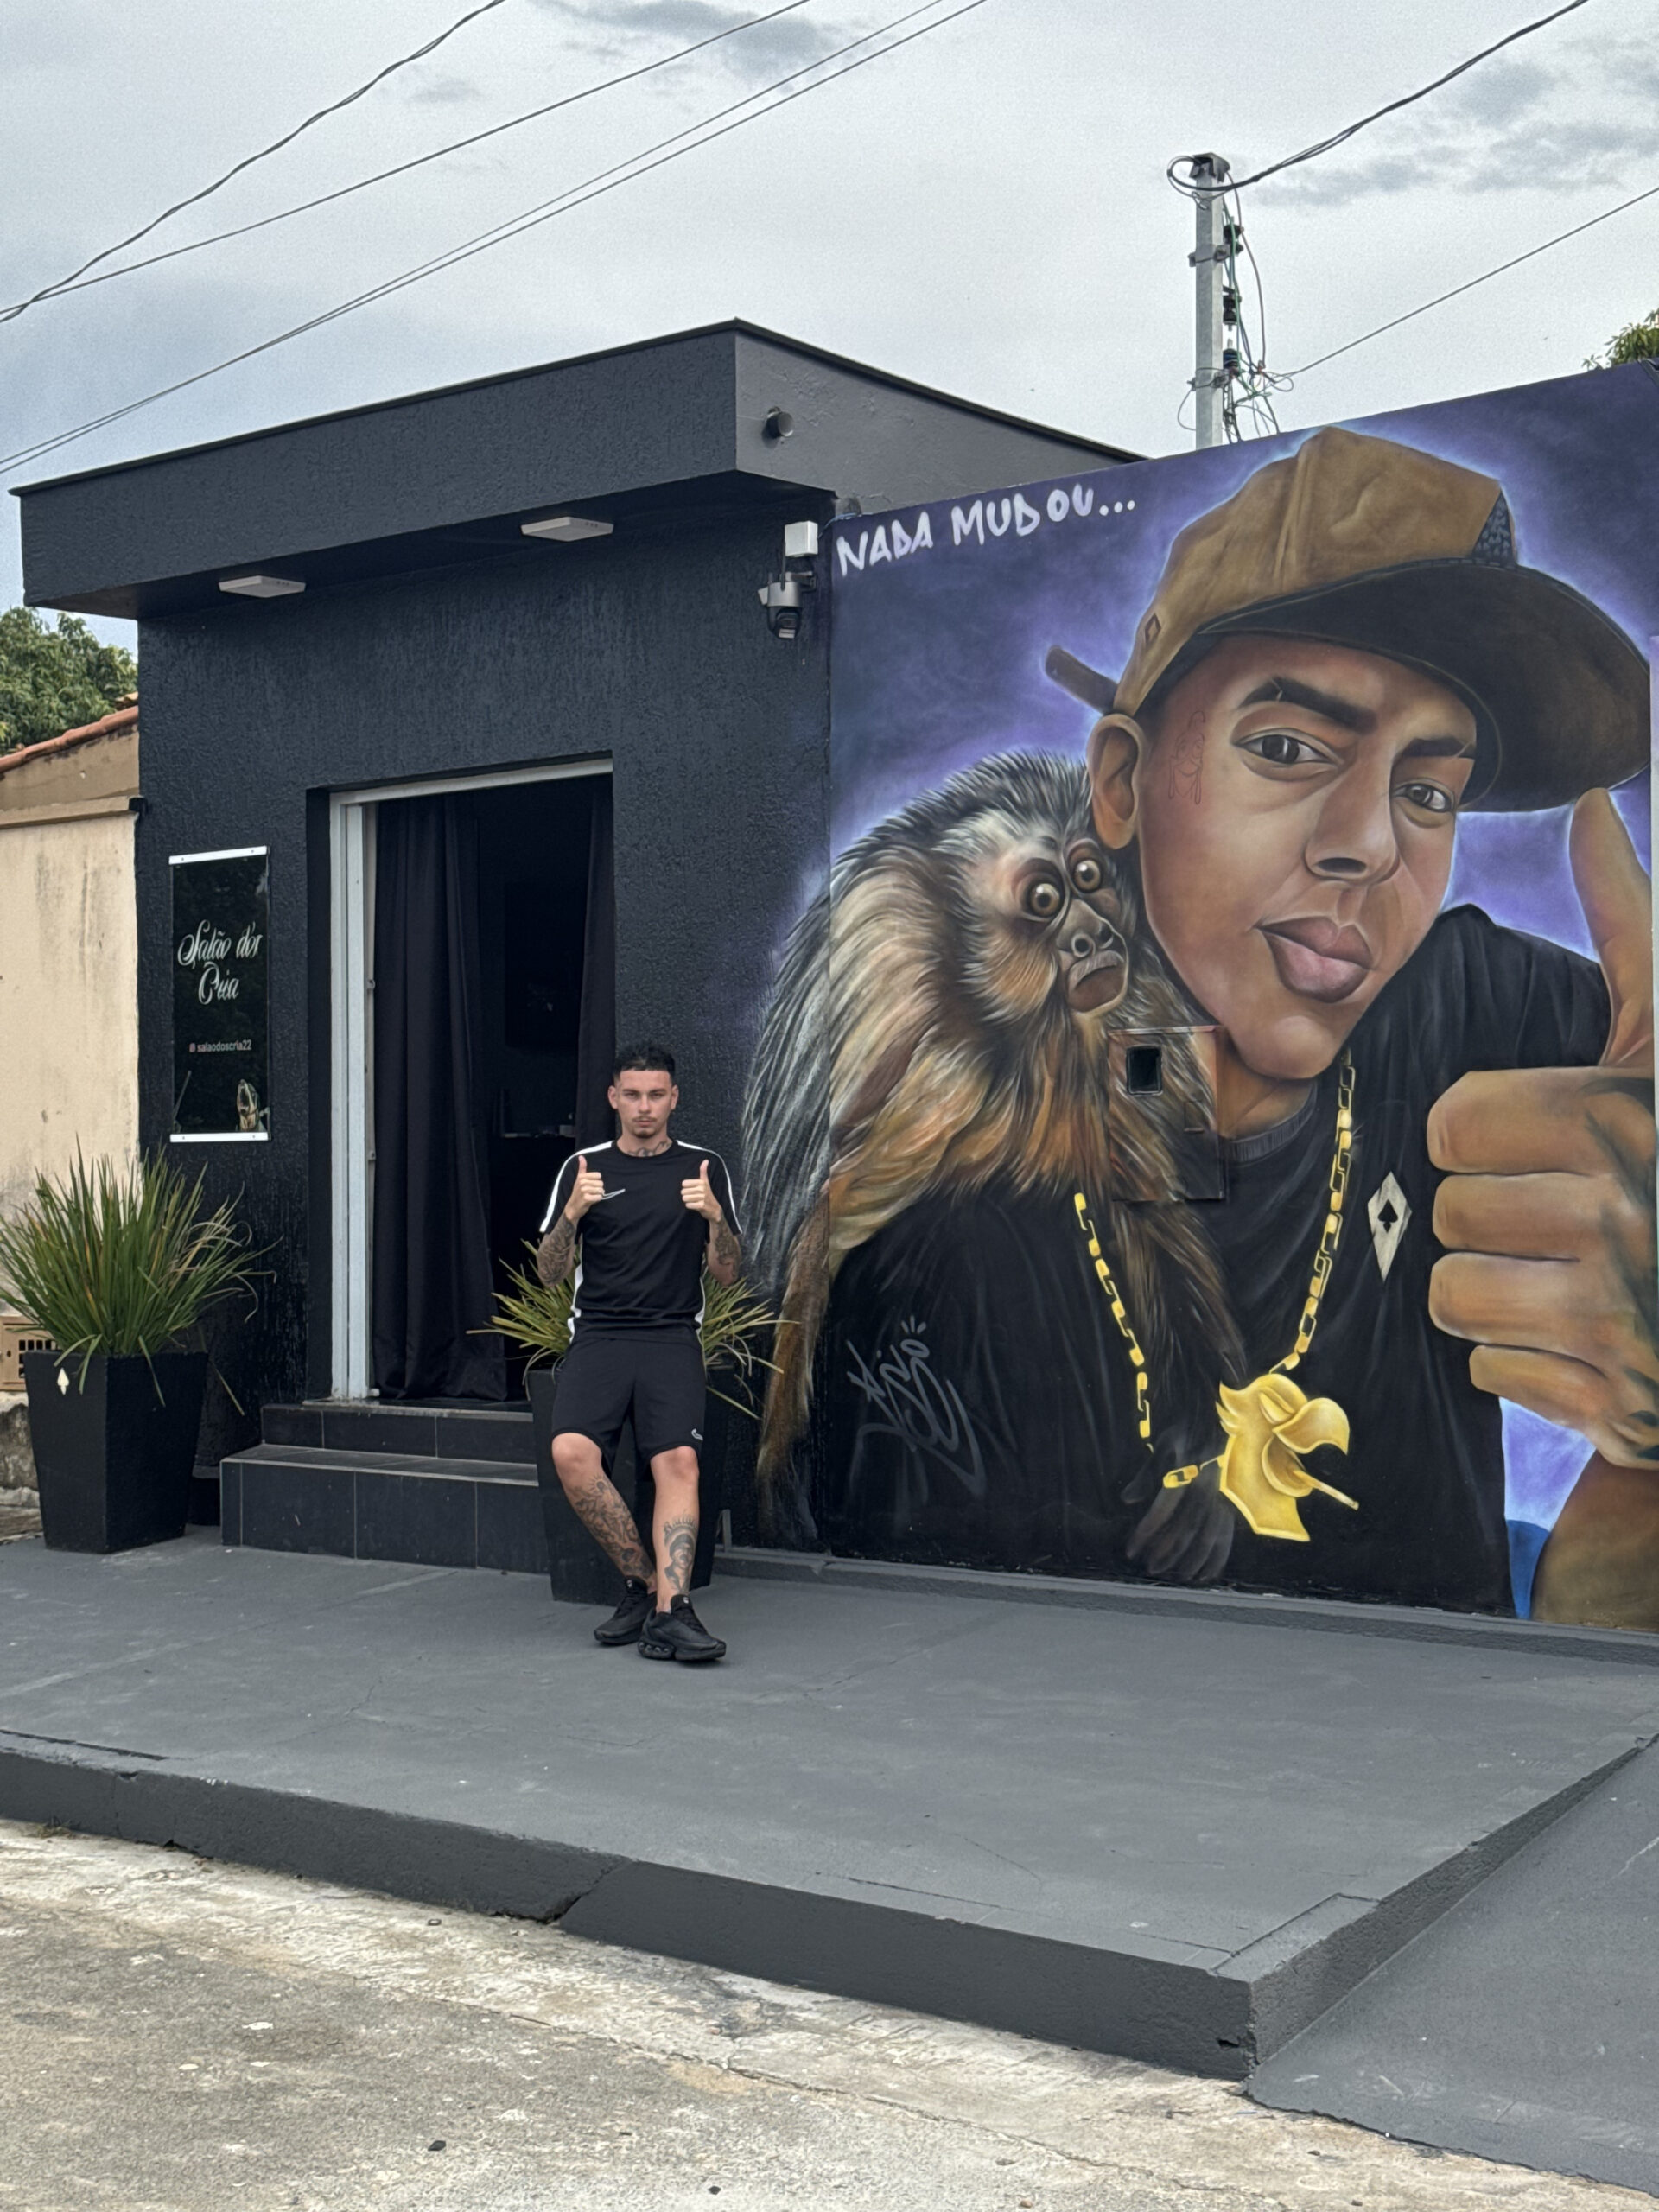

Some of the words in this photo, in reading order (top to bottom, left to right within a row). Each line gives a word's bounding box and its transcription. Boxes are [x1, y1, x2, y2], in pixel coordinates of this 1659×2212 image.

[836, 512, 933, 576] NADA
[177, 919, 232, 969] Salão
[199, 961, 239, 1005] Cria
